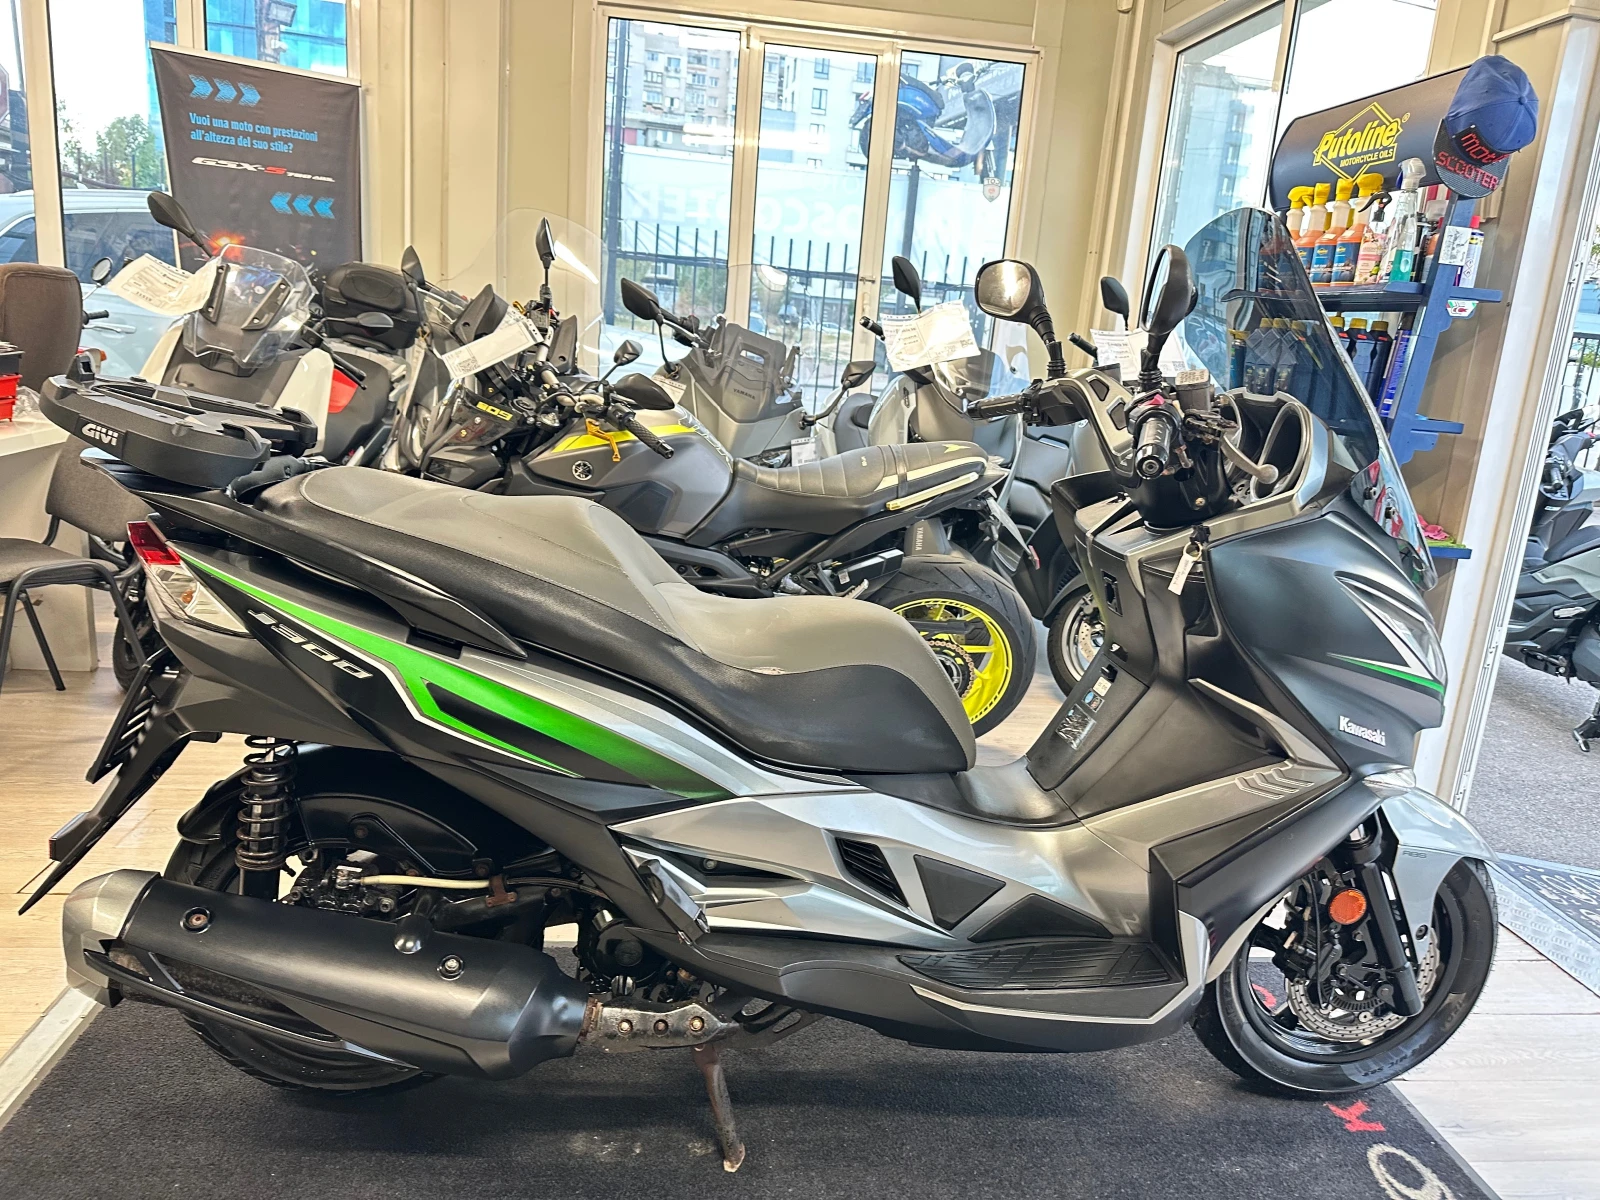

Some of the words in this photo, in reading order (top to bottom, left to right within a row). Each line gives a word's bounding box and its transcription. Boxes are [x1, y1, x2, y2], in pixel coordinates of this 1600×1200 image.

[189, 112, 210, 126] Vuoi
[212, 118, 229, 129] una
[231, 120, 253, 133] moto
[255, 124, 271, 135] con
[272, 126, 318, 142] prestazioni
[190, 129, 236, 145] all'altezza
[237, 135, 251, 148] del
[253, 140, 268, 150] suo
[270, 141, 294, 154] stile?
[1339, 151, 1379, 168] MOTORCYCLE
[1379, 149, 1394, 159] OILS
[1435, 151, 1499, 191] SCOOTER
[733, 388, 756, 400] YAMAHA
[81, 423, 119, 446] GIVI
[915, 527, 924, 551] YAMAHA
[1339, 715, 1387, 747] Kawasaki
